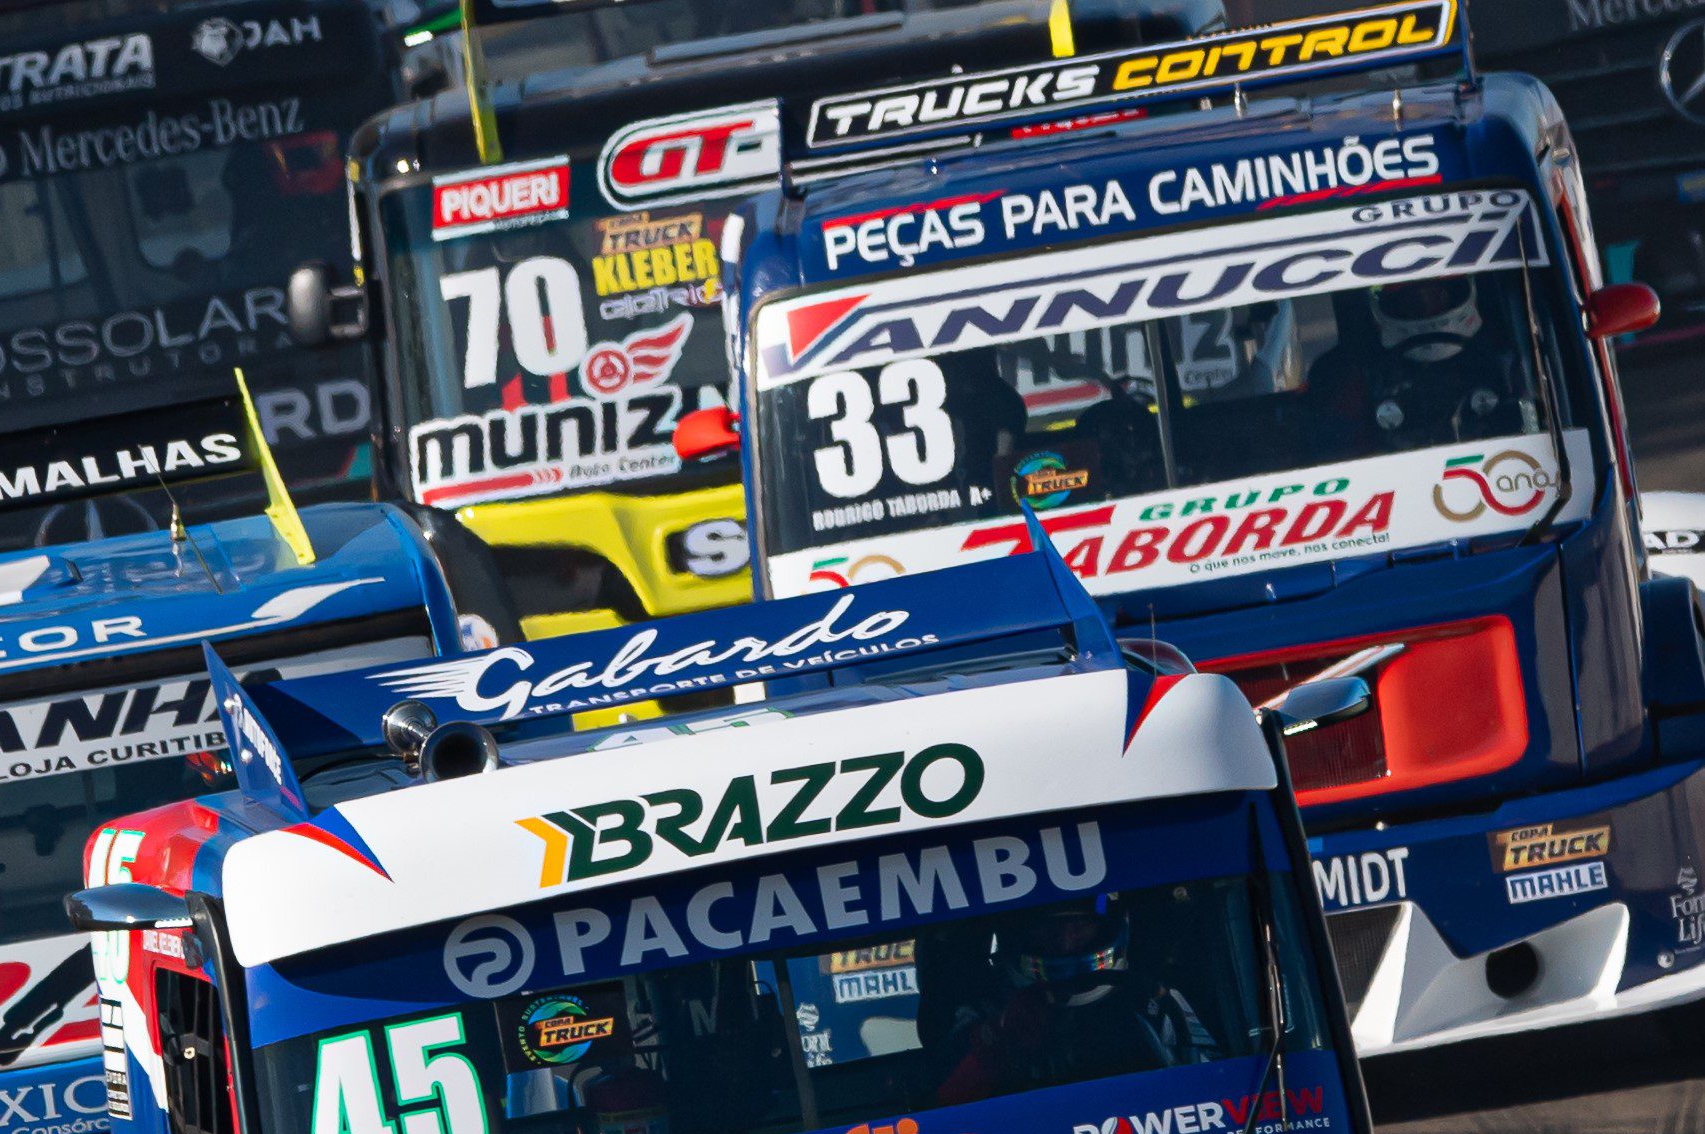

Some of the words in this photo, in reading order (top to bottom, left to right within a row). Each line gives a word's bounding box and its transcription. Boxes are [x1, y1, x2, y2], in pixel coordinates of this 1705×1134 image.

[826, 66, 1101, 136] TRUCKS
[1111, 13, 1436, 91] CONTROL
[18, 98, 305, 178] Mercedes-Benz
[441, 172, 560, 222] PIQUERI
[824, 201, 986, 270] PEÇAS
[1001, 175, 1137, 238] PARA
[1149, 135, 1440, 215] CAMINHÕES
[1352, 190, 1528, 225] GRUPO
[592, 238, 719, 297] KLEBER
[439, 255, 588, 389] 70
[415, 395, 677, 484] muniz
[807, 357, 956, 498] 33
[1138, 477, 1351, 521] GRUPO
[1204, 558, 1230, 572] que
[1232, 554, 1256, 567] nos
[455, 593, 910, 722] Gabardo
[528, 674, 728, 715] TRANSPORTE
[735, 667, 774, 683] DE
[780, 633, 940, 674] VEÍCULOS
[87, 730, 229, 766] CURITIB
[541, 742, 986, 883] BRAZZO
[1511, 828, 1549, 842] COPA
[1510, 832, 1605, 864] TRUCK
[553, 820, 1109, 977] PACAEMBU
[1509, 866, 1604, 900] MAHLE
[838, 969, 914, 999] MAHL
[544, 1021, 610, 1043] TRUCK
